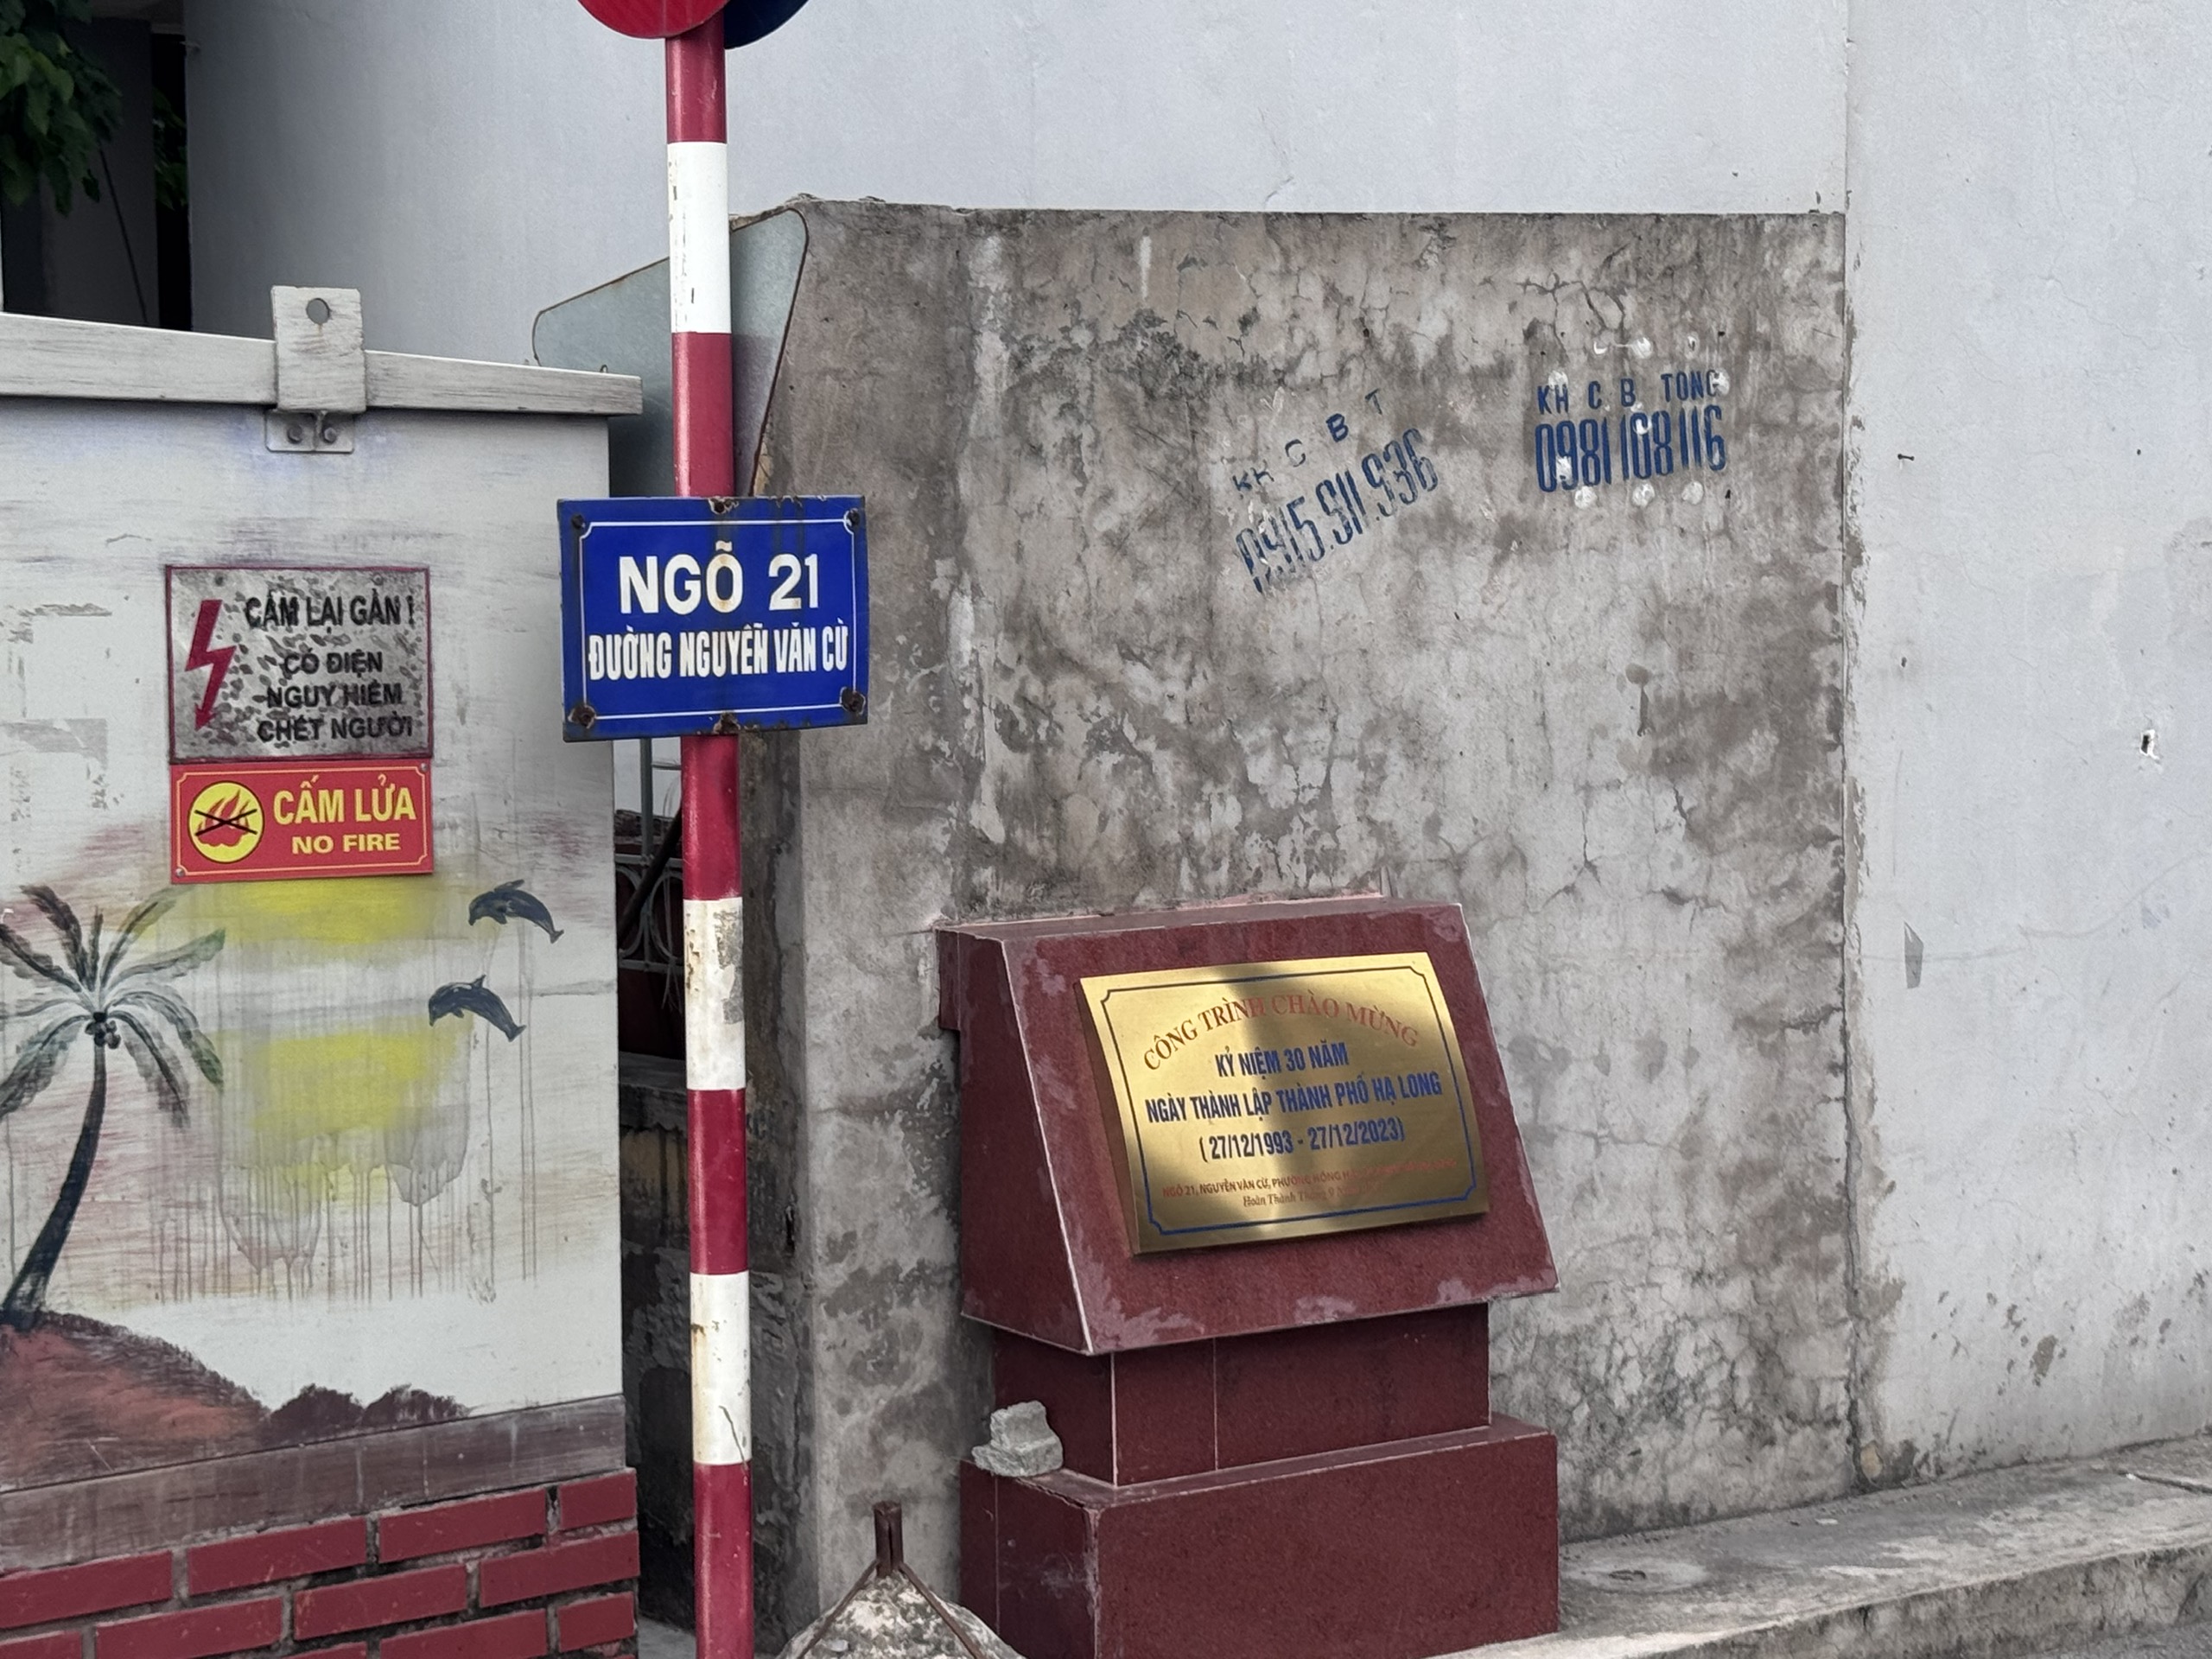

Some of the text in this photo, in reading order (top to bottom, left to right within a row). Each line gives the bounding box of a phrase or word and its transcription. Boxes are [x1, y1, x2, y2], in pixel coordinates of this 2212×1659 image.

[1536, 384, 1569, 415] KH
[1588, 380, 1602, 410] C
[1621, 378, 1636, 407] B
[1325, 413, 1351, 442] B
[620, 539, 819, 615] NGÕ 21
[306, 596, 344, 634] LẠI
[283, 648, 383, 678] CÓ ĐIỆN
[588, 618, 849, 681] ĐƯỜNG NGUYỄN VĂN CỪ
[267, 683, 336, 709] NGUY
[331, 710, 413, 739] NGƯỜI
[273, 773, 416, 824] CẤM LỬA
[292, 833, 401, 855] NO FIRE
[1144, 989, 1418, 1070] CÔNG TRÌNH CHÀO MỪNG
[1215, 1039, 1350, 1079] KỶ NIỆM 30 NĂM
[1145, 1071, 1443, 1123] NGÀY THÀNH LẬP THÀNH PHỐ HẠ LONG
[1307, 1116, 1406, 1151] 27/12/2023)
